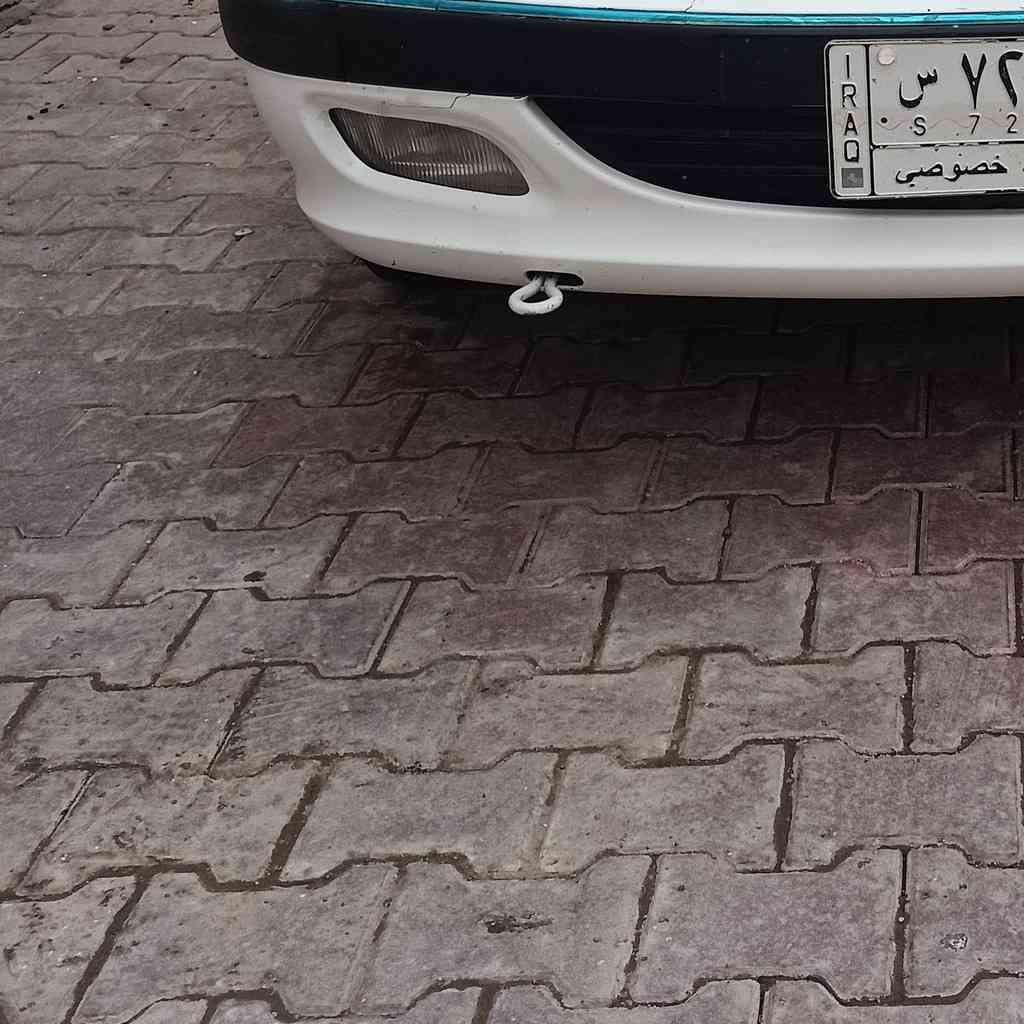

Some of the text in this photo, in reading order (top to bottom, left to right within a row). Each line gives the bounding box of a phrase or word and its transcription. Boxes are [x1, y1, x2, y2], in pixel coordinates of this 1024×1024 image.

[898, 67, 938, 109] س
[840, 53, 861, 163] IRAQ
[912, 115, 927, 136] S
[894, 154, 1009, 188] خصوصي
